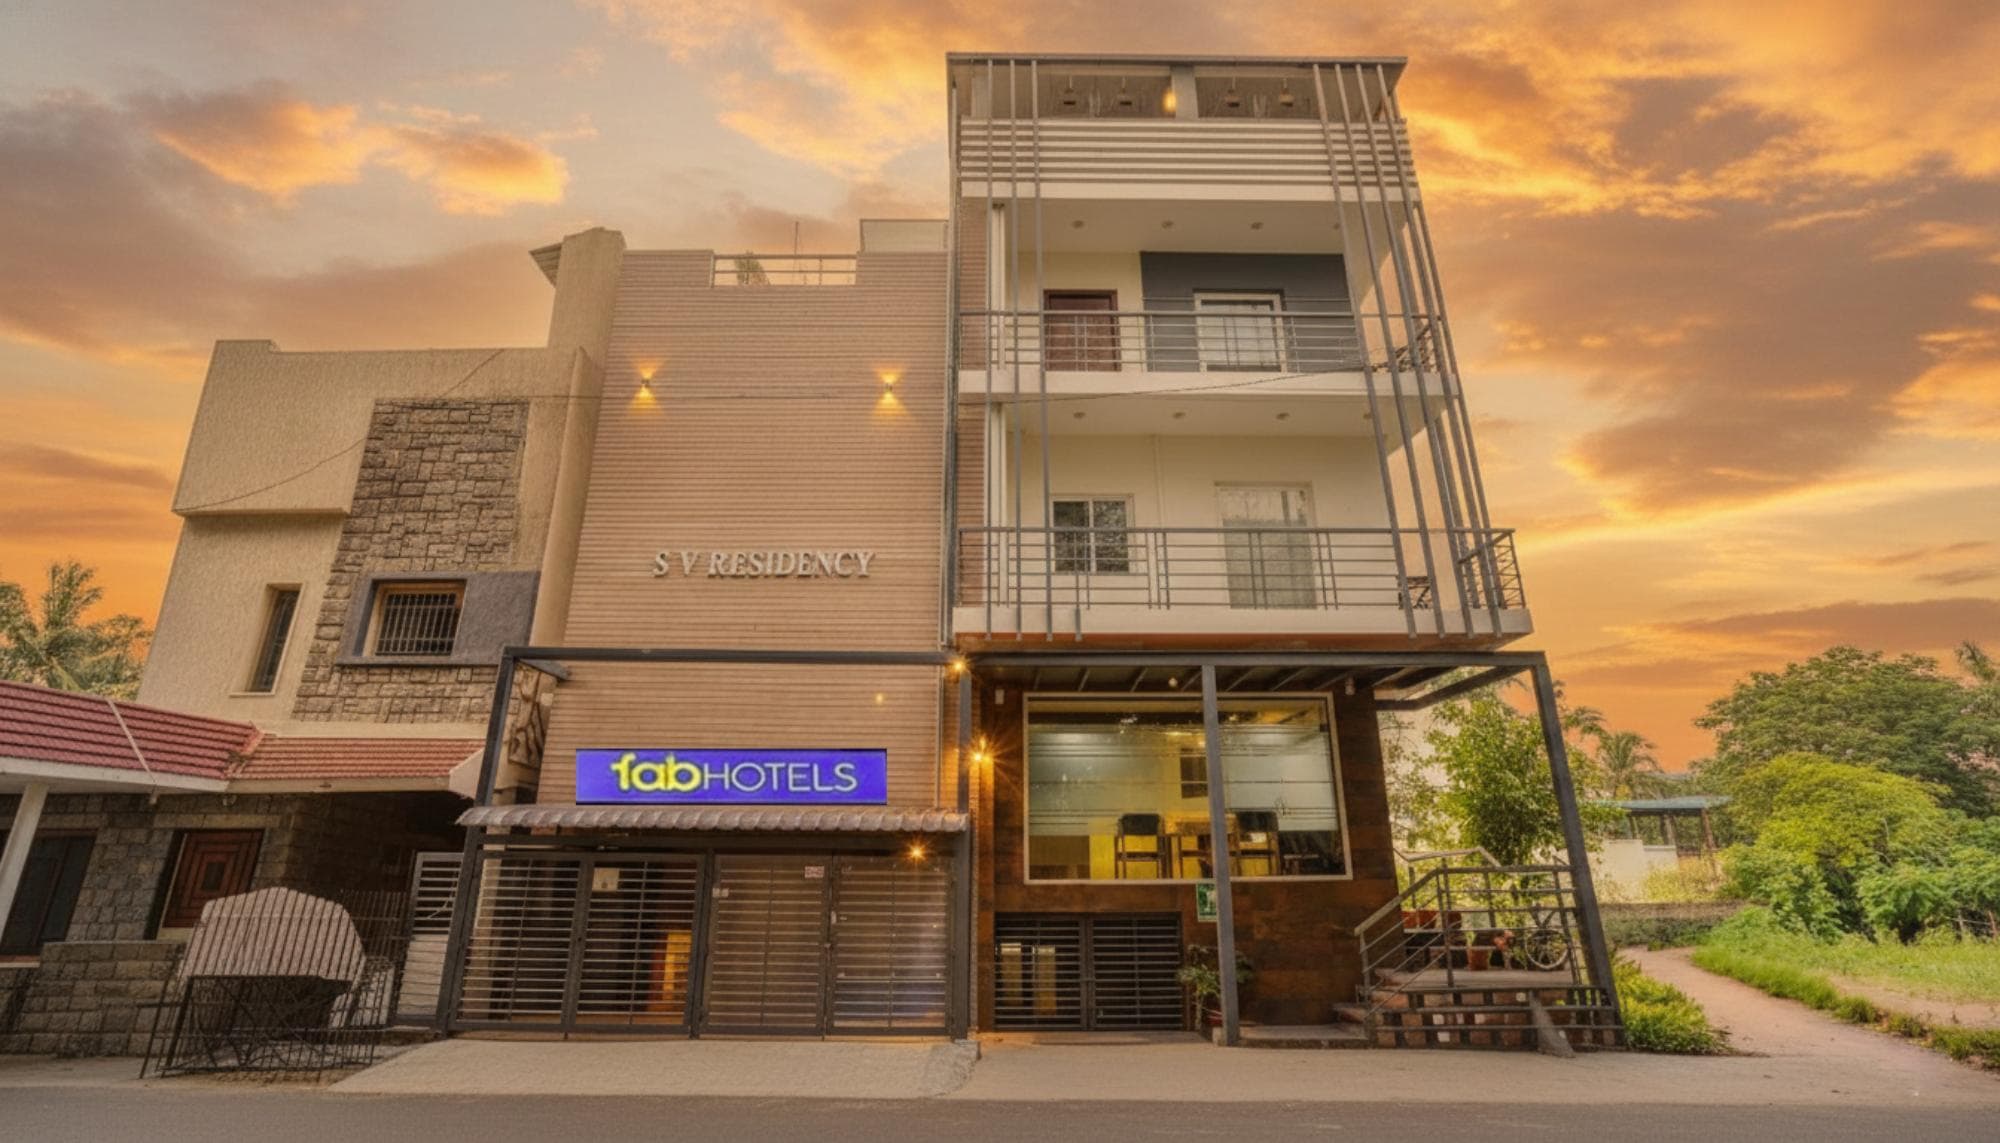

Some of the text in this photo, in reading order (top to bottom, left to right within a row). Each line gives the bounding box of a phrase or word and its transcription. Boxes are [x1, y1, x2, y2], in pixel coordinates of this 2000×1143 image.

[653, 550, 876, 579] S V RESIDENCY
